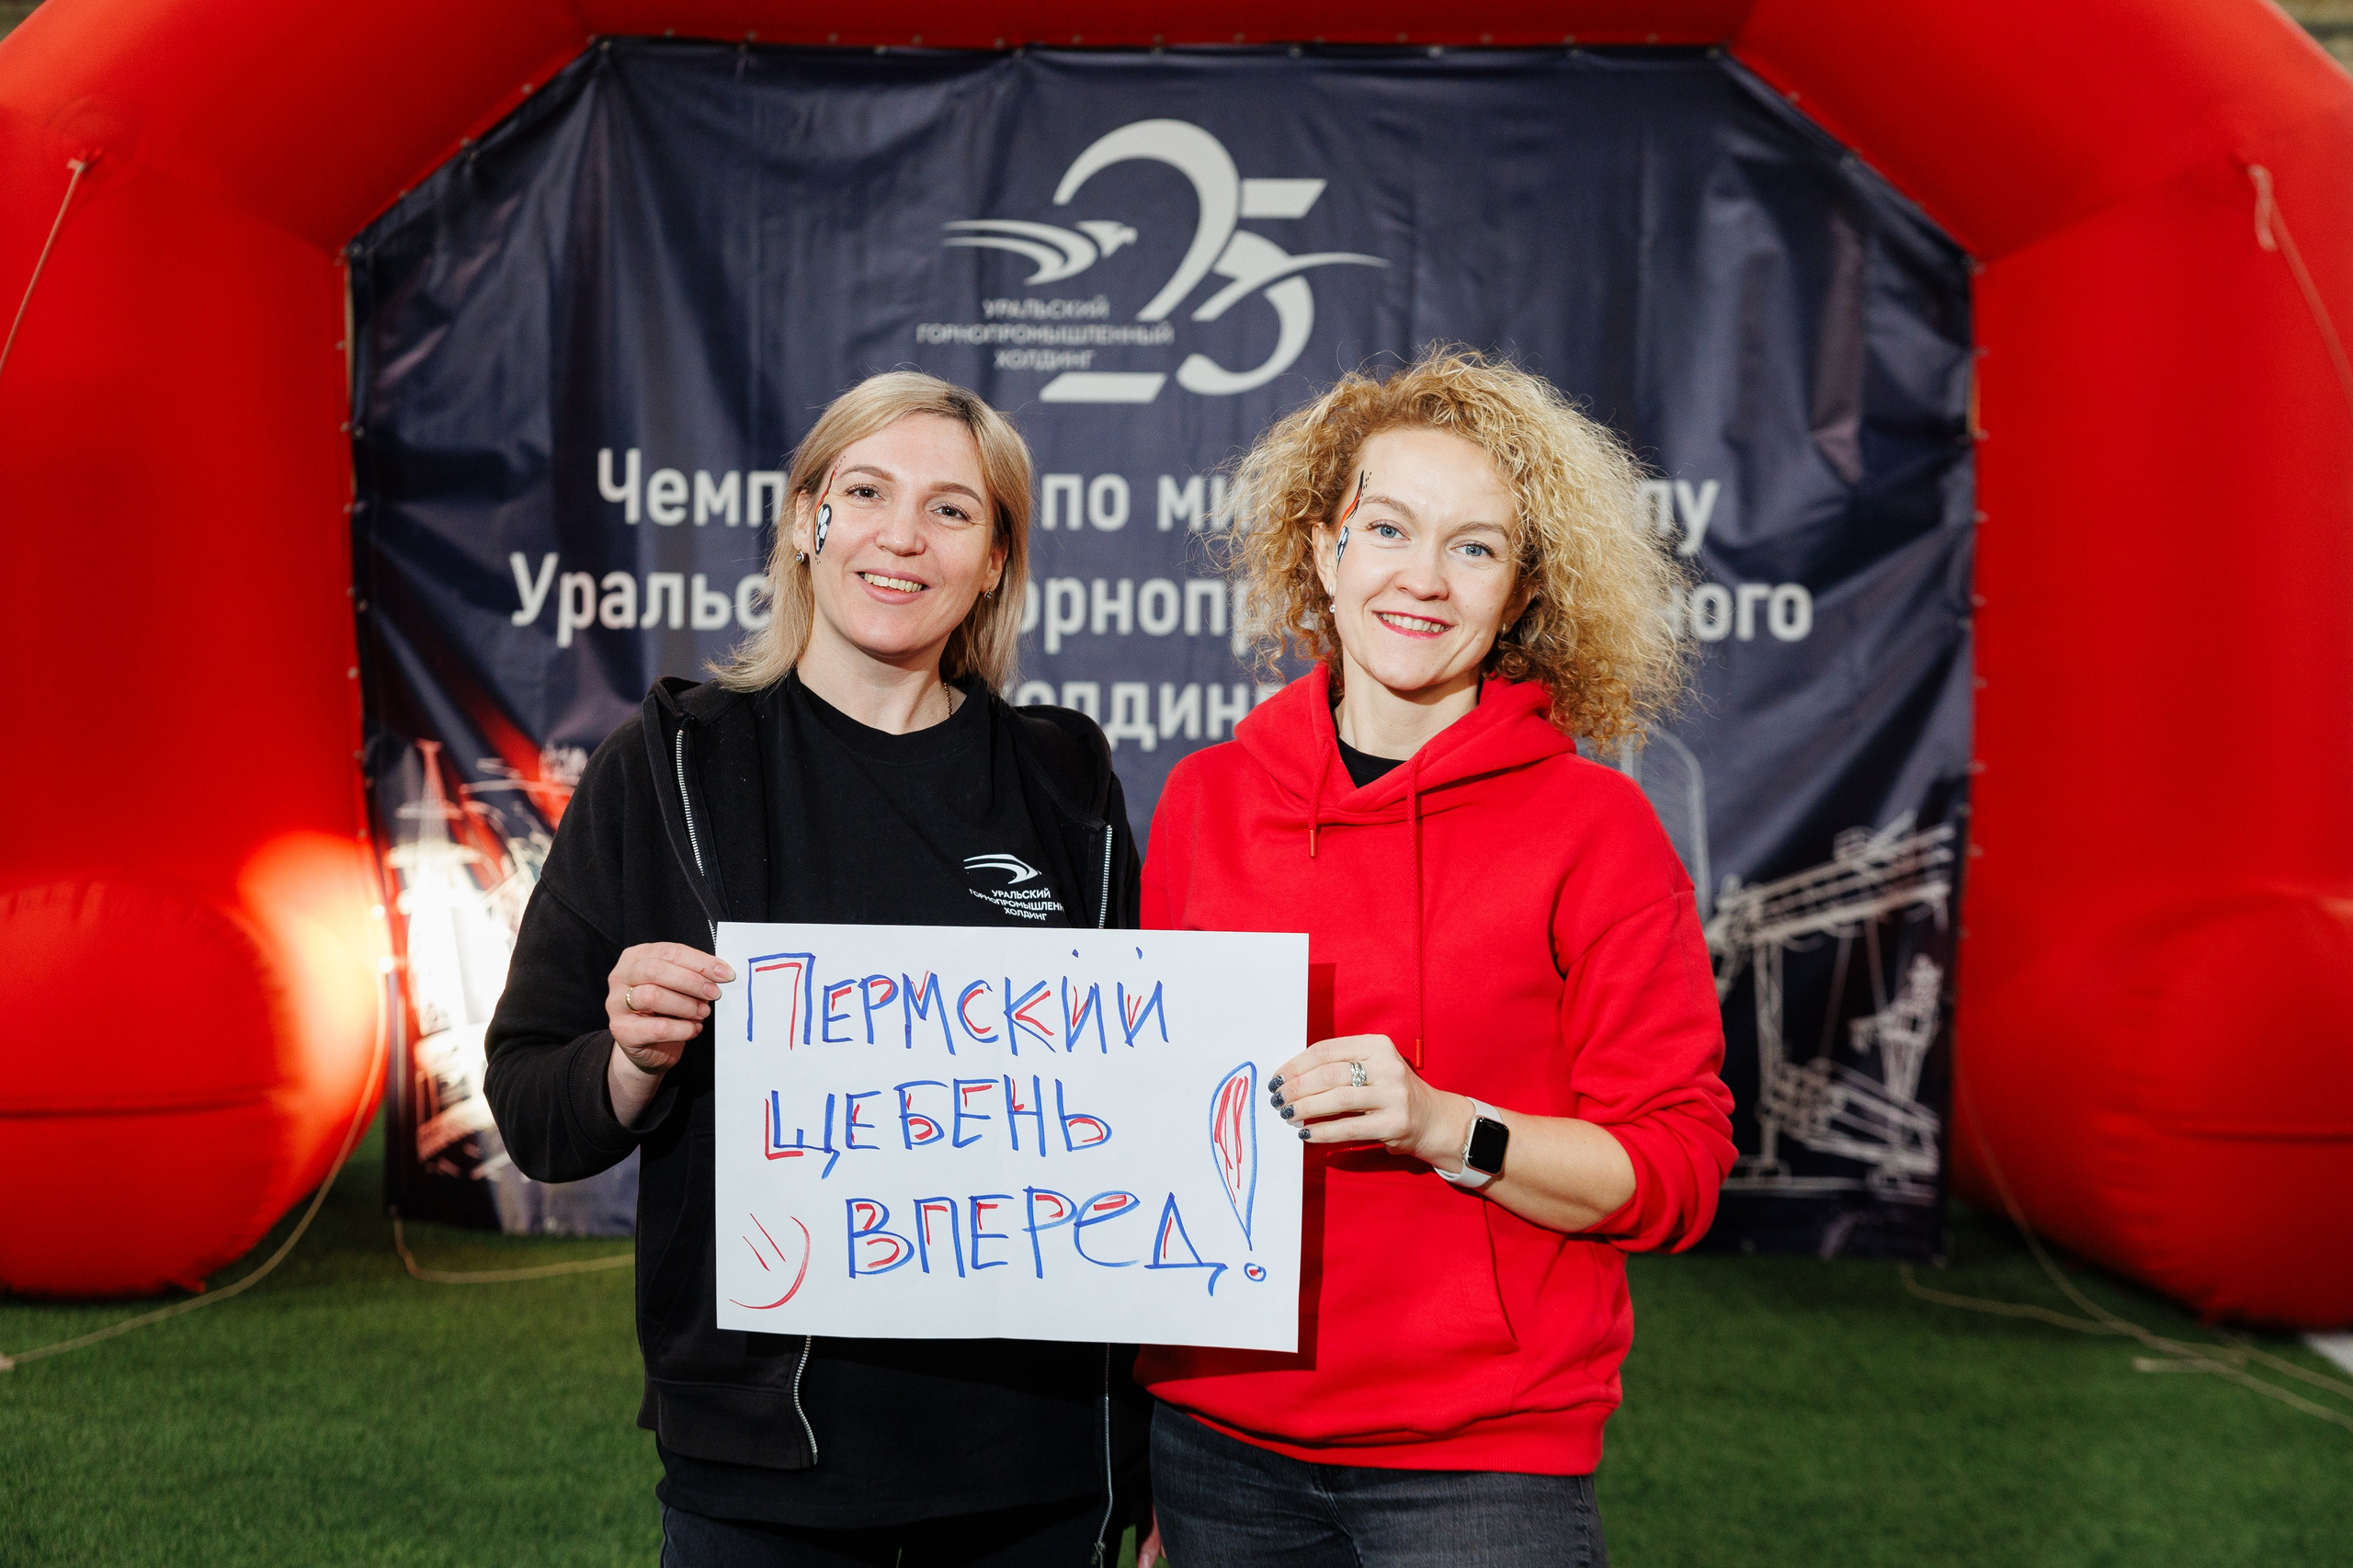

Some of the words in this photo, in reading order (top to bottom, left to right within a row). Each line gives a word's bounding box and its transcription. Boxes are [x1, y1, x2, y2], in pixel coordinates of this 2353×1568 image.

[1040, 118, 1327, 403] 25
[983, 294, 1110, 319] УРАЛЬСКИЙ
[916, 322, 1175, 345] ГОРНОПРОМЫШЛЕННЫЙ
[995, 349, 1095, 370] ХОЛДИНГ
[1041, 472, 1131, 531] по
[992, 888, 1051, 899] УРАЛЬСКИЙ
[1004, 906, 1047, 921] ХОЛДИНГ
[746, 948, 1170, 1056] ПЕРМСКИЙ
[764, 1074, 1112, 1180] ЩЕБЕНЬ
